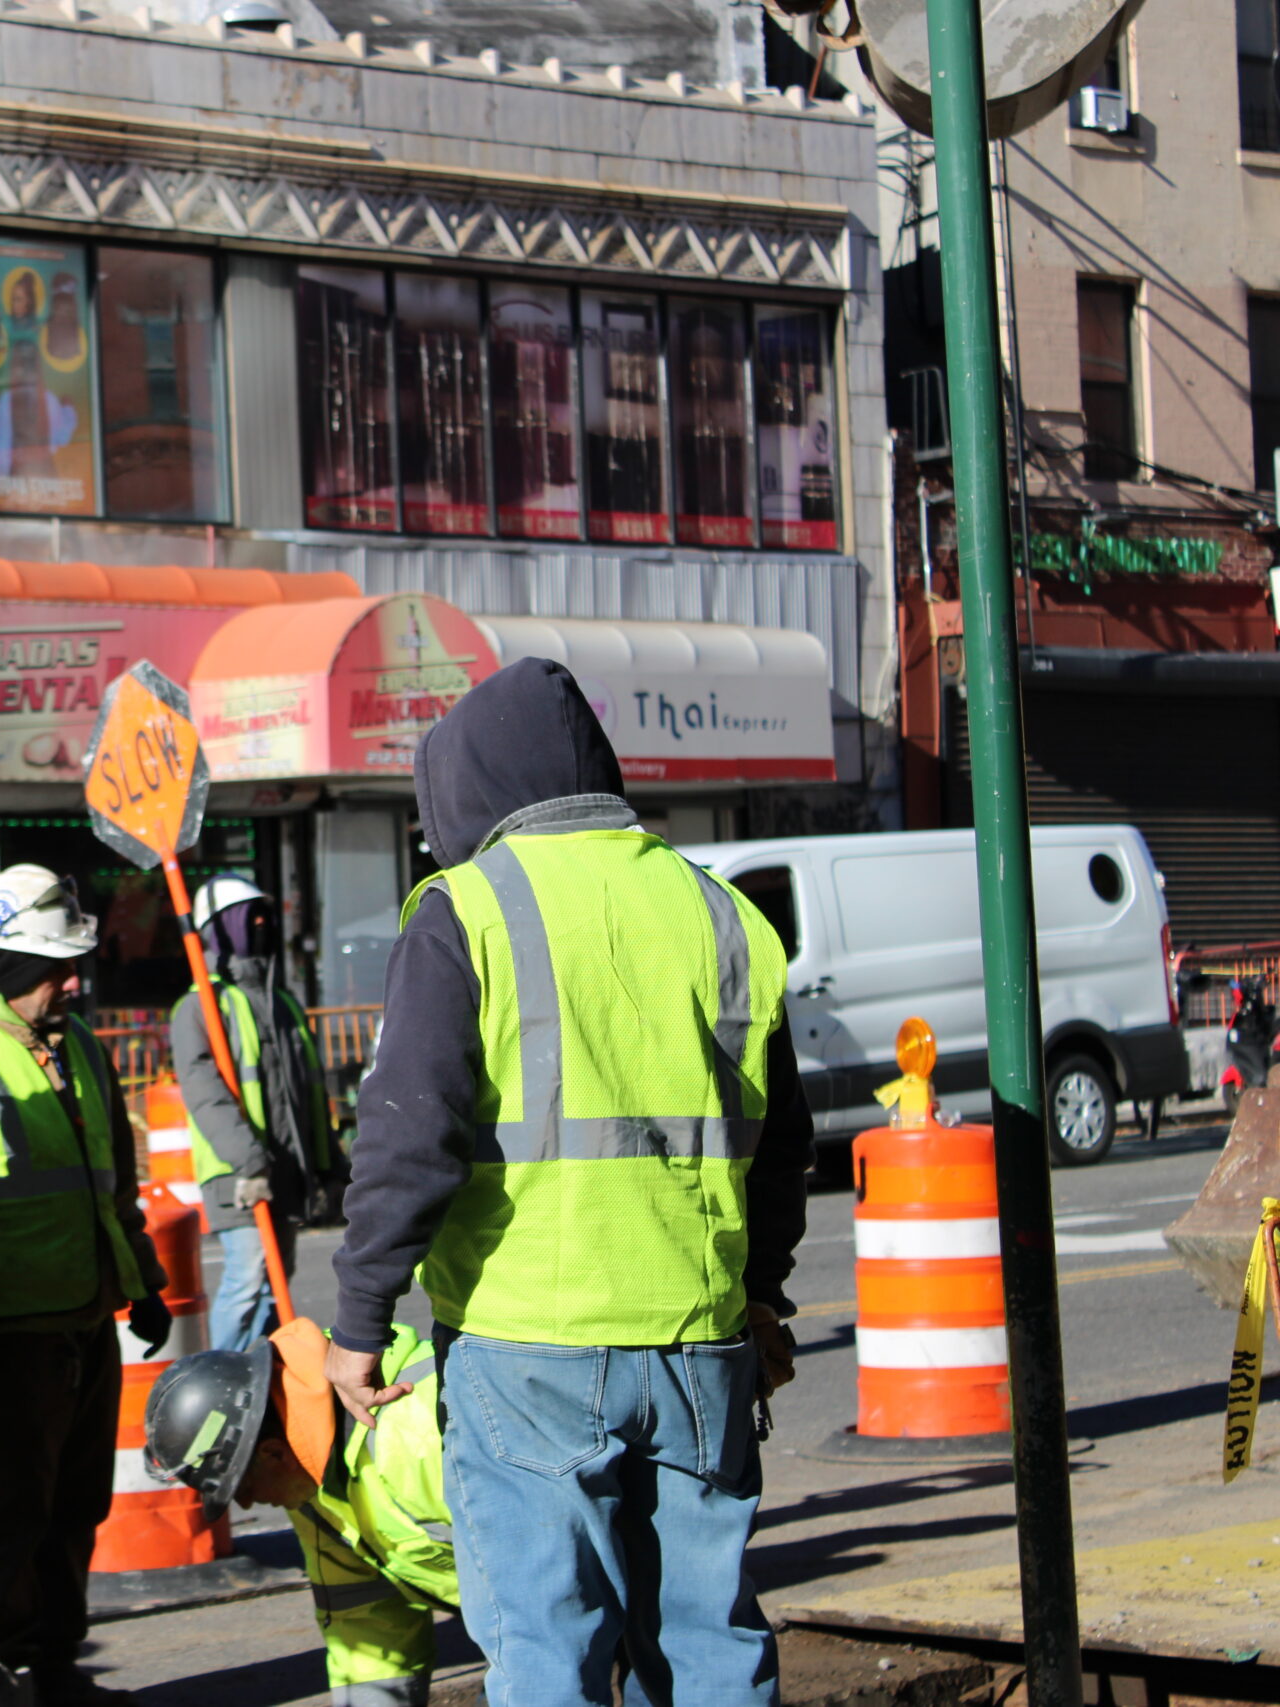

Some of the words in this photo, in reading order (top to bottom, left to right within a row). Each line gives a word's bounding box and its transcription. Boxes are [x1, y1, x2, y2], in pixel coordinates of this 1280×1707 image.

[634, 691, 719, 741] Thai
[722, 713, 788, 734] Express
[99, 713, 185, 813] SLOW
[620, 764, 666, 779] elivery
